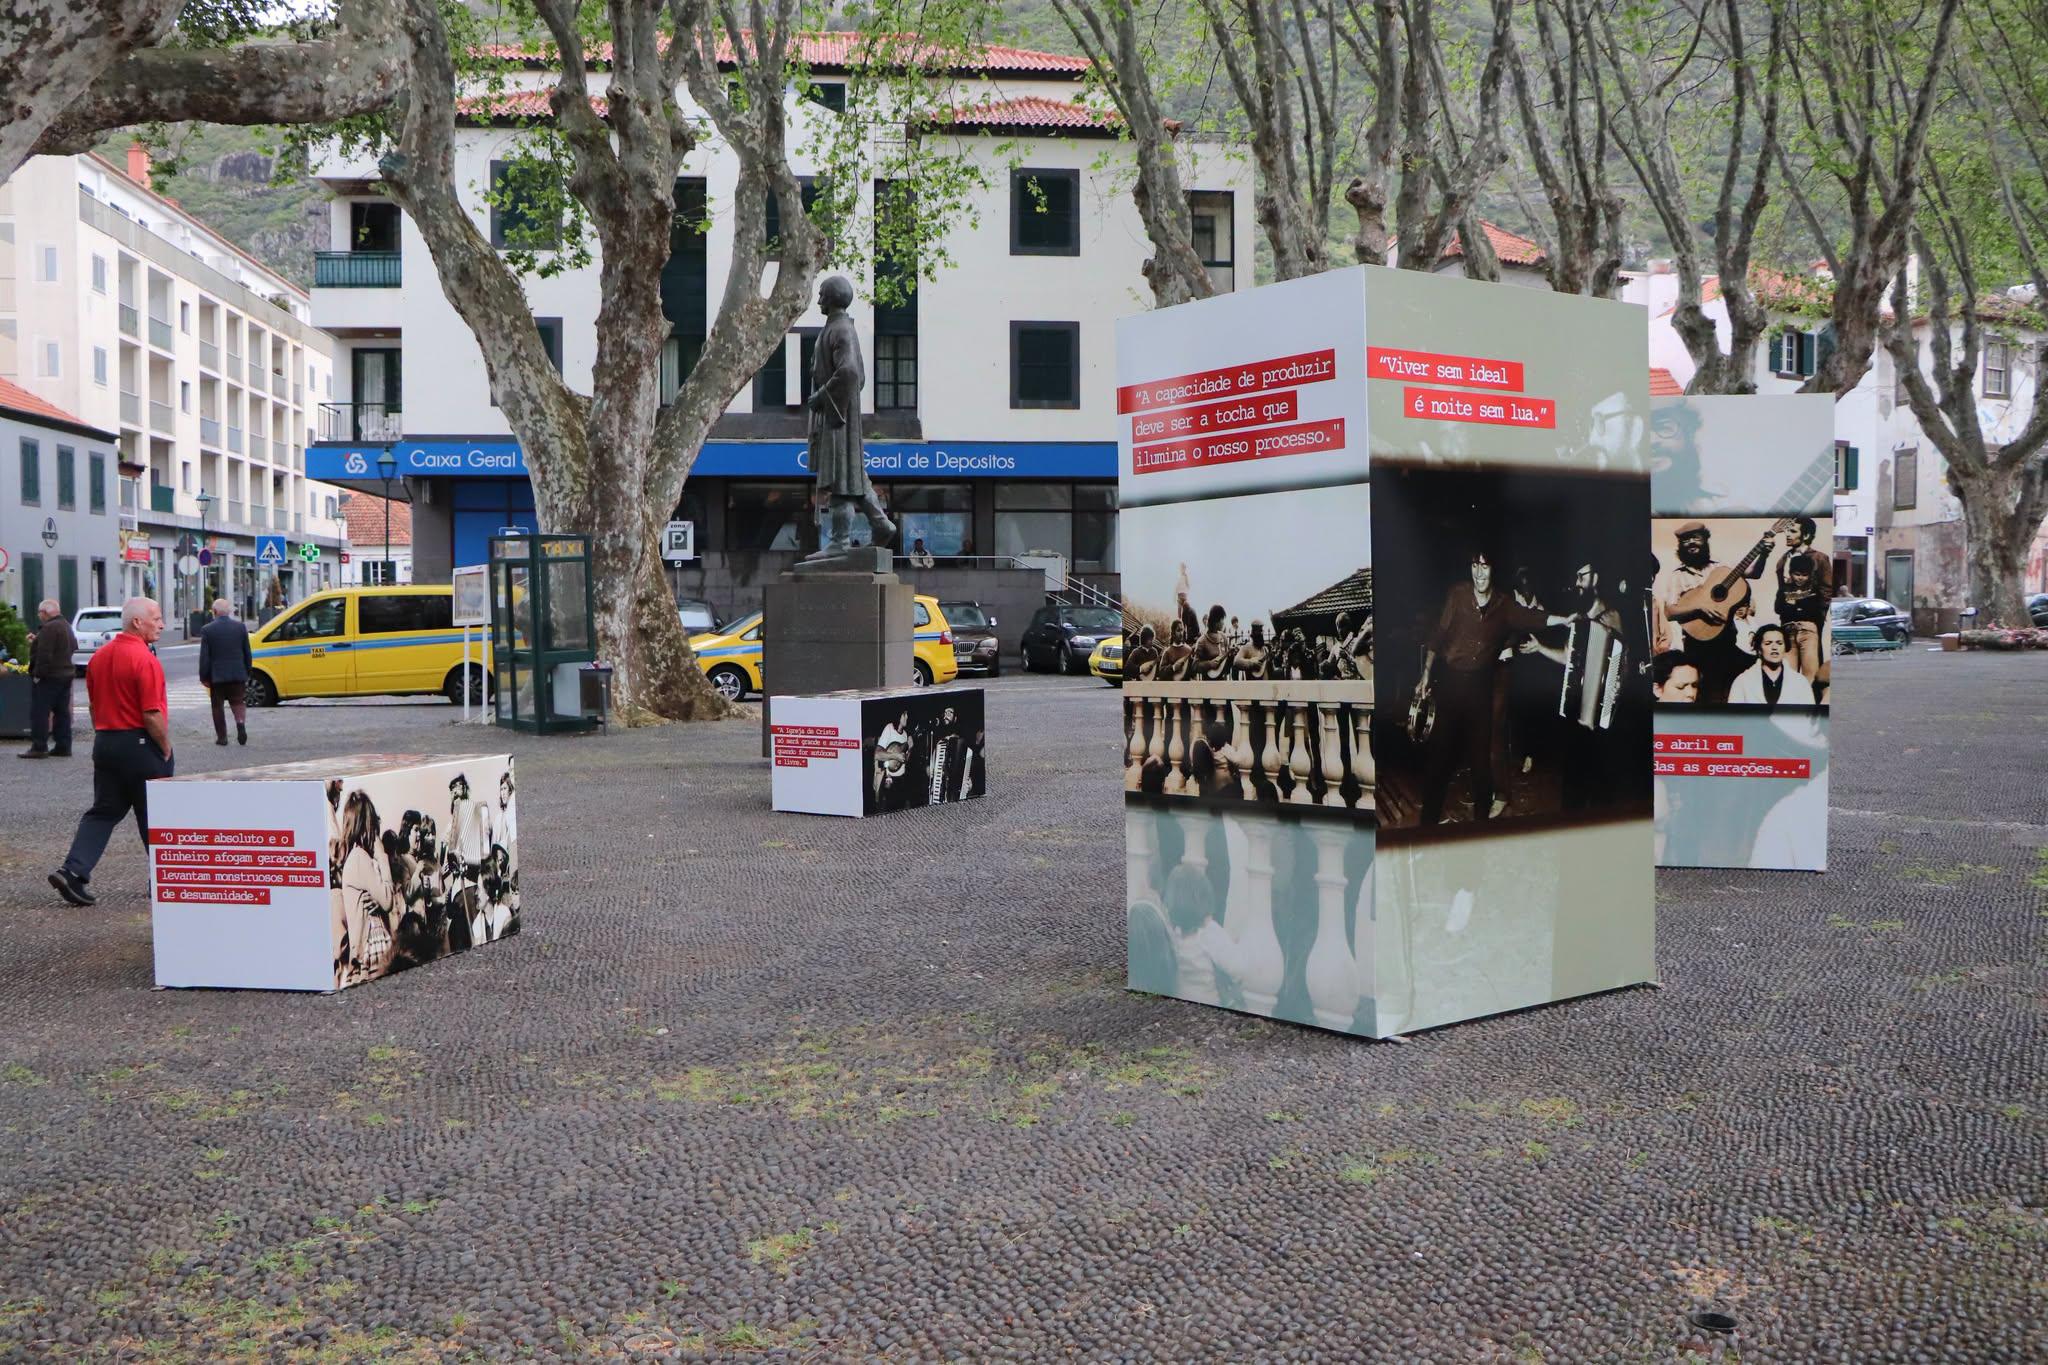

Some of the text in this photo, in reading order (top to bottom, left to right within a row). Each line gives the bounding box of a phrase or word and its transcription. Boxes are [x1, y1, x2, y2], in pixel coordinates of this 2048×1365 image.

[1379, 356, 1509, 384] “Viver sem ideal
[1135, 358, 1331, 405] “A capacidade de produzir
[1414, 395, 1547, 422] é noite sem lua.”
[1135, 401, 1289, 437] deve ser a tocha que
[1136, 423, 1340, 468] ilumina o nosso processo."
[410, 449, 461, 468] Caixa
[467, 449, 516, 468] Geral
[907, 453, 929, 469] de
[671, 532, 685, 550] P
[542, 543, 584, 555] TAXI
[786, 727, 805, 736] Igreja
[801, 738, 820, 746] grande
[1653, 739, 1735, 751] e abril em
[777, 748, 796, 756] quando
[1683, 763, 1699, 773] as
[160, 832, 289, 846] “O poder absoluto e o
[160, 851, 313, 867] dinheiro afogam gerações,
[162, 870, 321, 884] levantam monstruosos muros
[162, 889, 265, 901] de desumanidade.”
